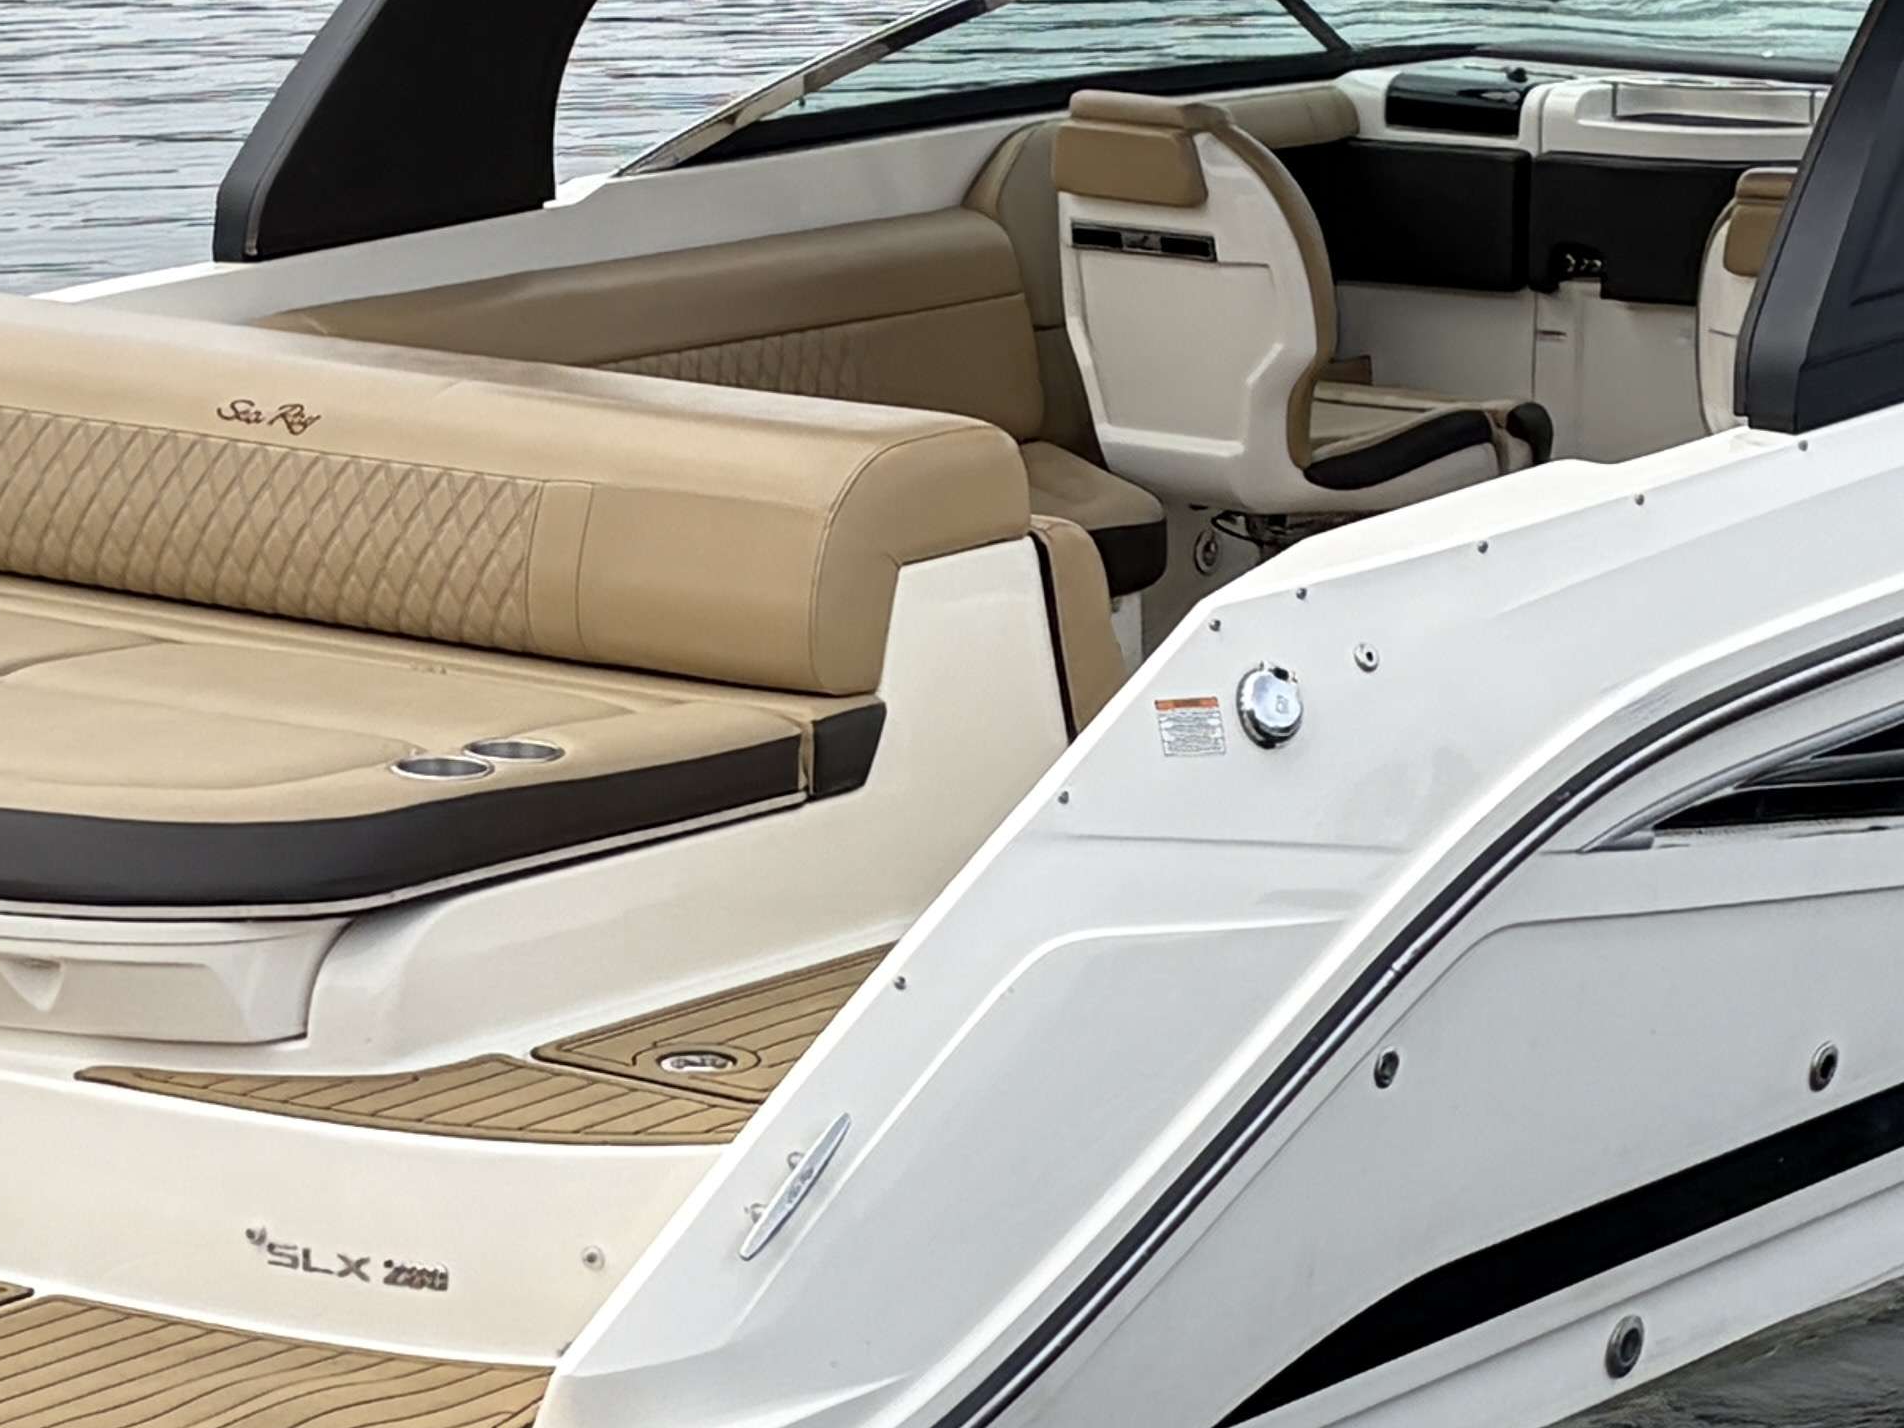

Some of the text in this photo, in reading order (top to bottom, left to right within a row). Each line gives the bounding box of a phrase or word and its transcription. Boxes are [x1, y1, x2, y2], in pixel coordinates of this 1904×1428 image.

[216, 399, 321, 436] Sea Ray
[267, 1241, 371, 1283] SLX
